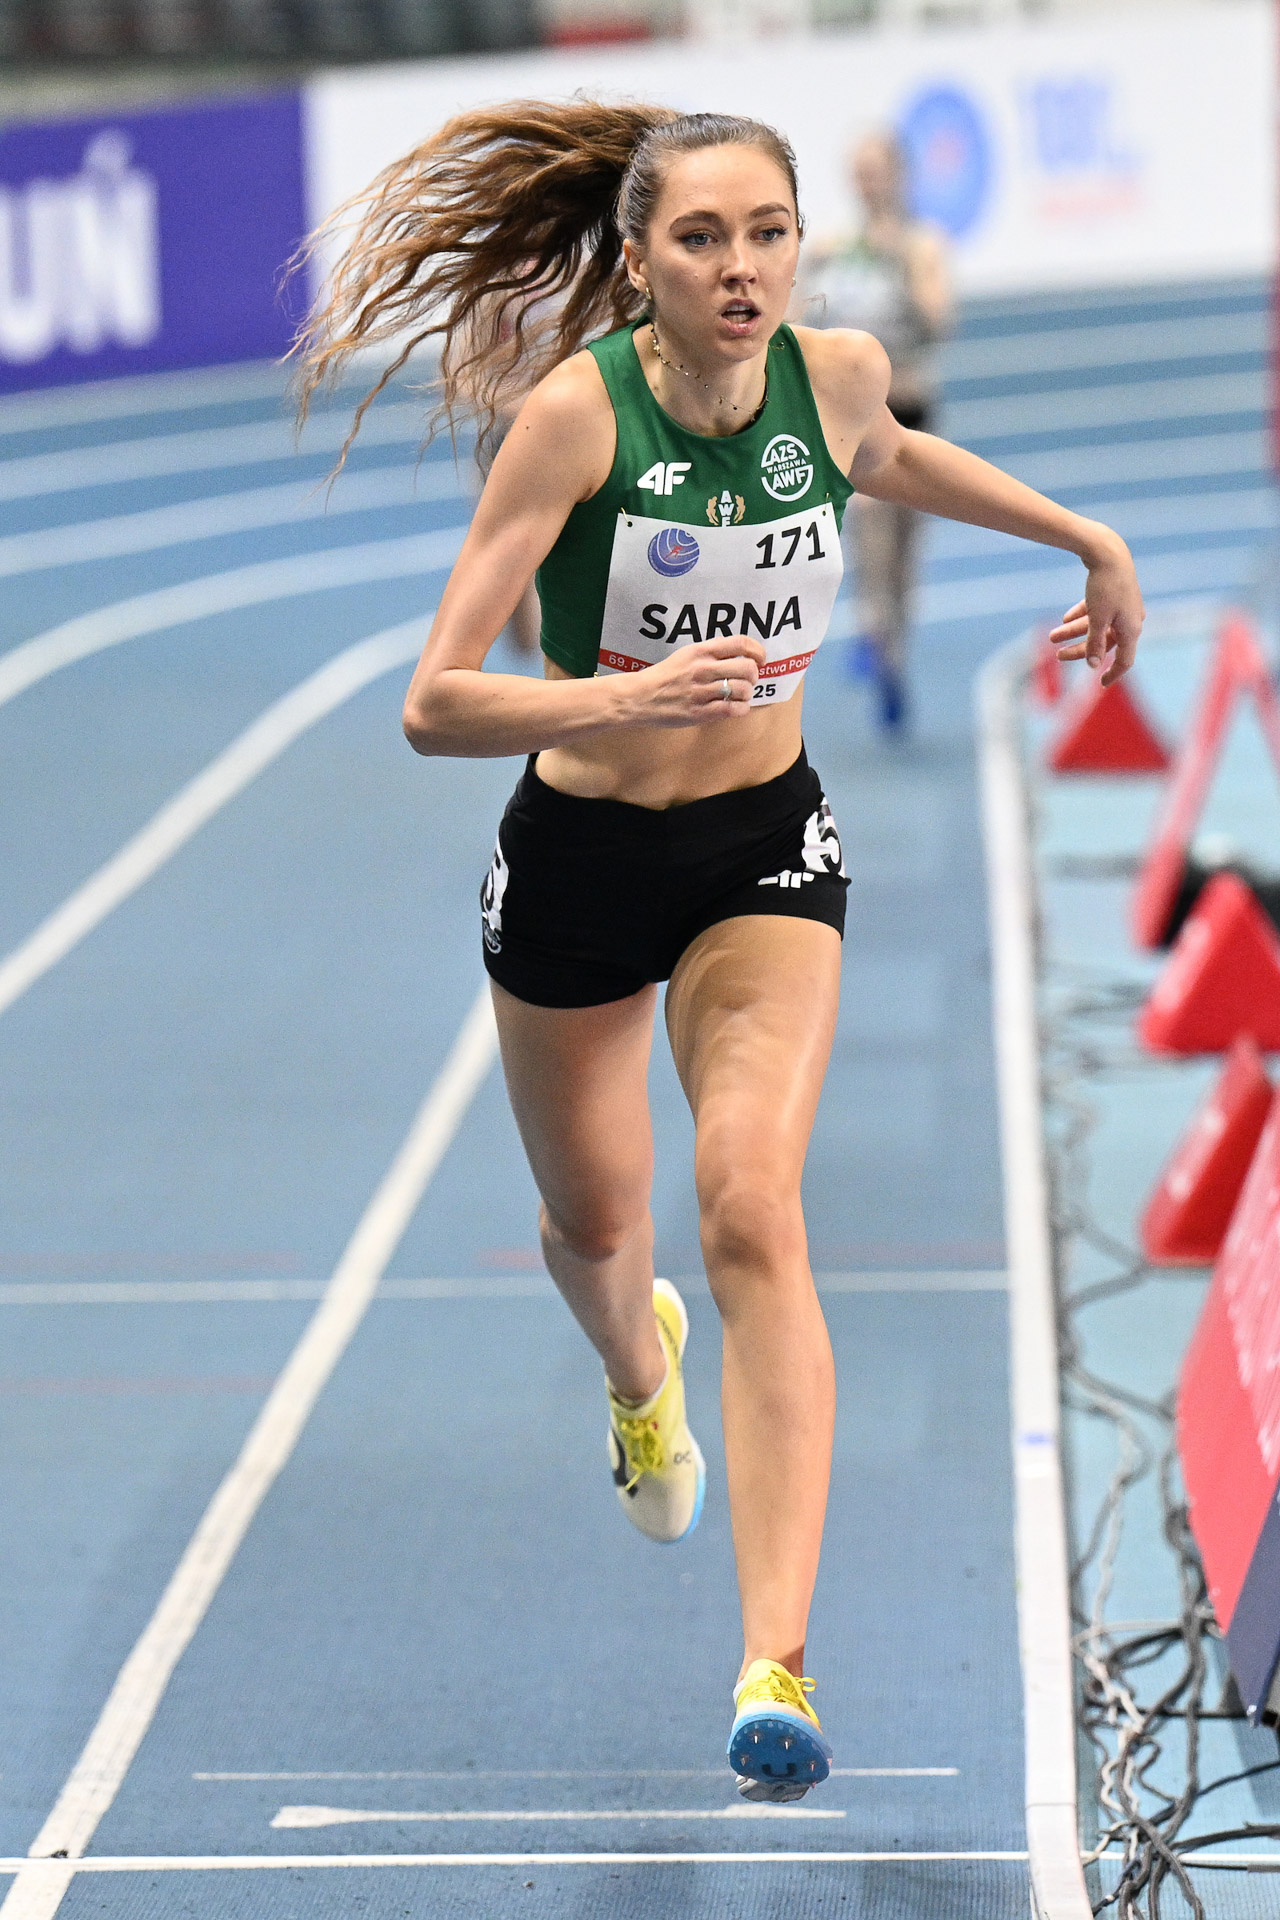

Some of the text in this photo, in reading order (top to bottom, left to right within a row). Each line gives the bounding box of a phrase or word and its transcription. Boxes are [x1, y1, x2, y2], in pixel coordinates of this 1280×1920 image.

[766, 458, 807, 474] WARSZAWA
[769, 442, 798, 464] AZS
[636, 461, 692, 496] 4F
[772, 465, 807, 491] AWF
[755, 521, 826, 570] 171
[638, 595, 803, 644] SARNA
[608, 653, 627, 669] 69.
